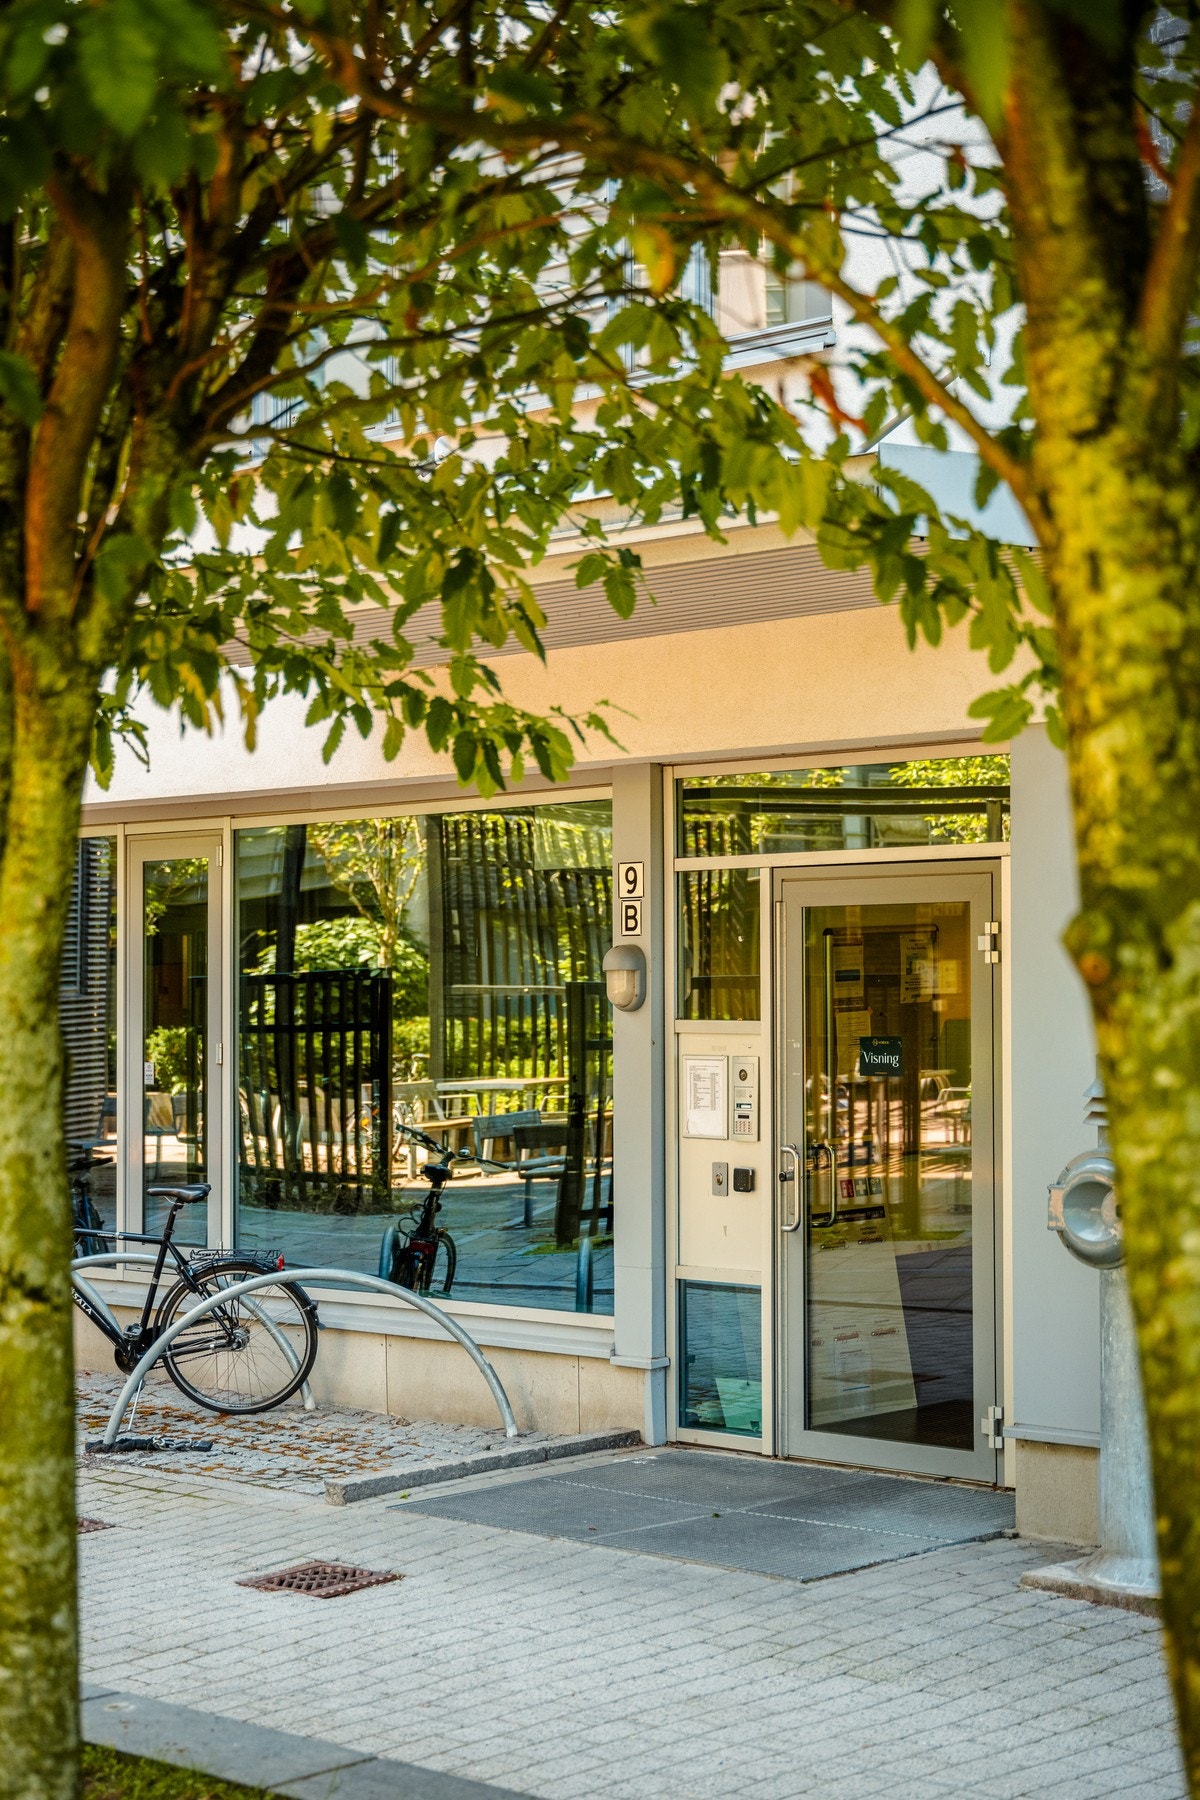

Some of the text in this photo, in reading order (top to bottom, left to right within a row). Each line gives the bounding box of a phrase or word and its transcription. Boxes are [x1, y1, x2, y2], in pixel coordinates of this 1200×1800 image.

[625, 866, 637, 894] 9
[625, 905, 638, 931] B
[863, 1051, 899, 1067] Visning
